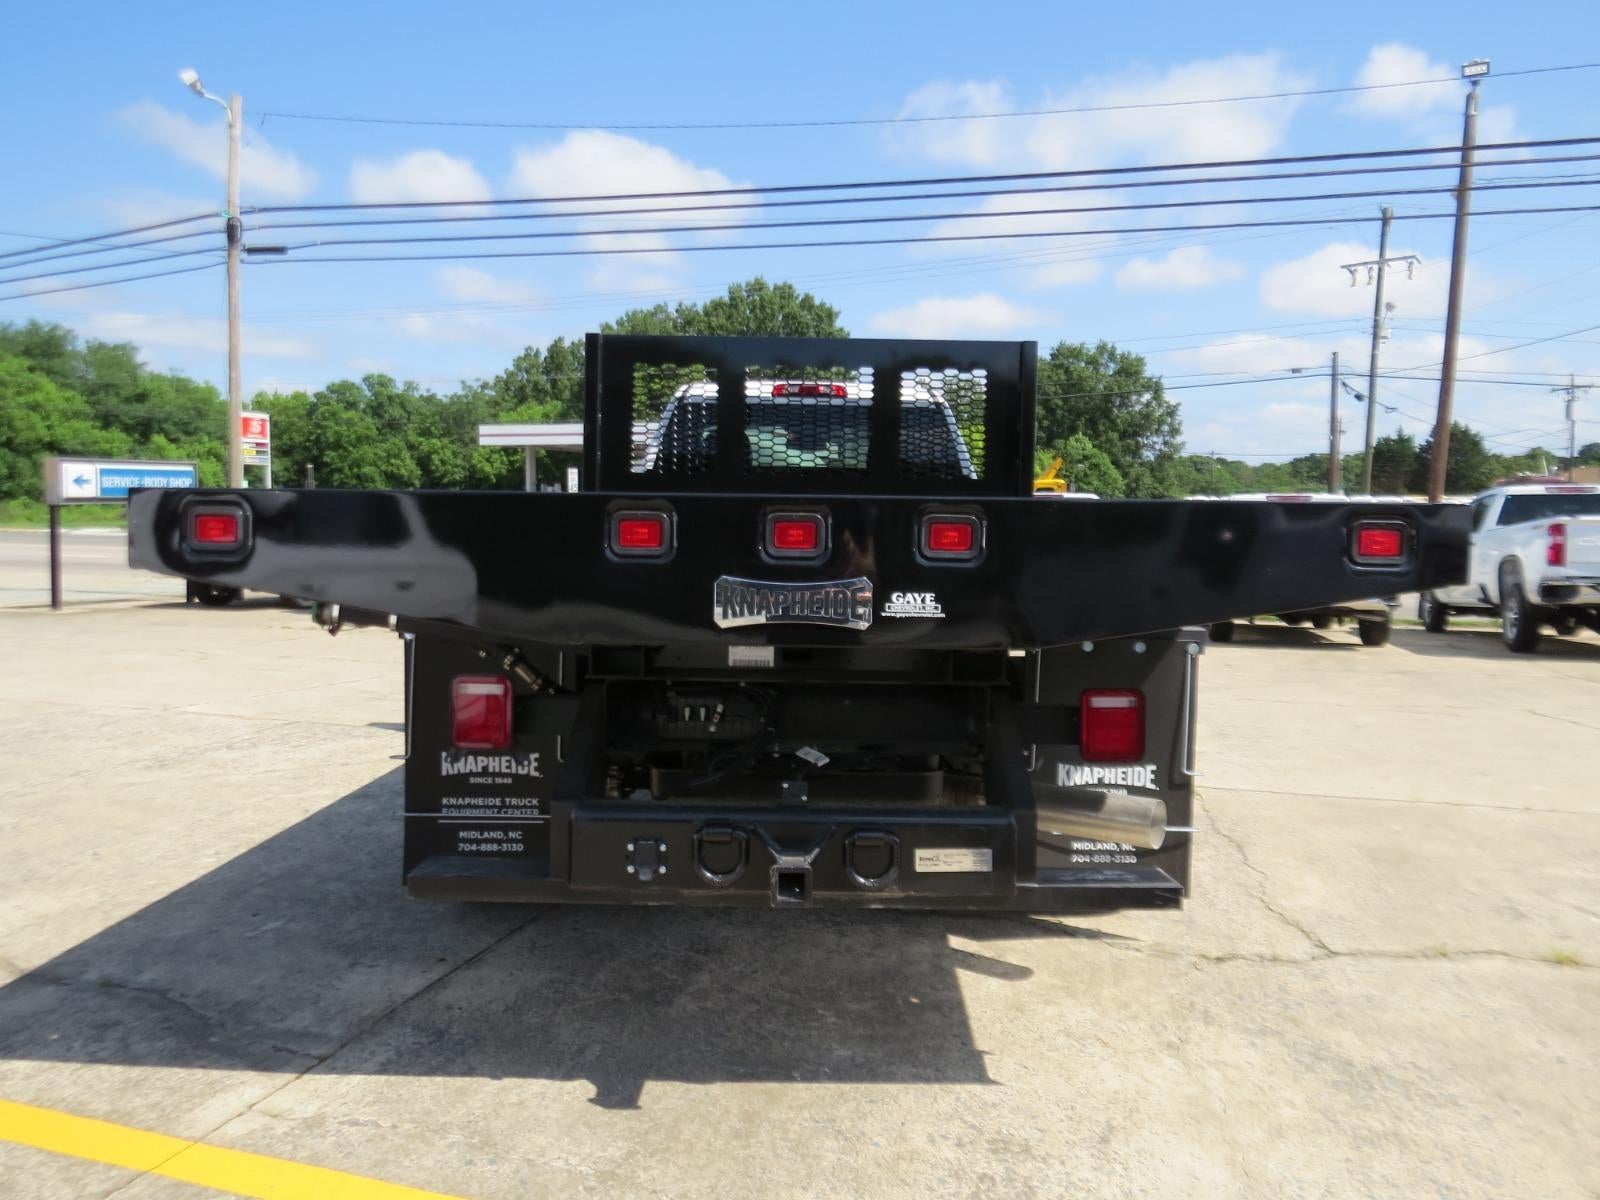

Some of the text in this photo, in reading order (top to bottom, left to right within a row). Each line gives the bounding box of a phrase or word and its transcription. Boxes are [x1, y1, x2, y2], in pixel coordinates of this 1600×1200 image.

[102, 476, 140, 488] SERVICE
[169, 477, 193, 488] SHOP
[721, 585, 867, 622] KNAPHEIDE
[891, 592, 936, 605] GAYE
[881, 611, 946, 619] www.gayechevrolet.com
[469, 777, 493, 785] SINCE
[1057, 763, 1159, 791] KNAPHEIDE
[442, 797, 540, 807] KNAPHEIDE TRUCK
[501, 808, 540, 817] CENTER
[459, 831, 523, 841] MIDLAND, NC
[458, 843, 525, 852] 704-888-3130
[1072, 842, 1120, 853] MIDLAND,
[1072, 854, 1138, 864] 704-888-3130
